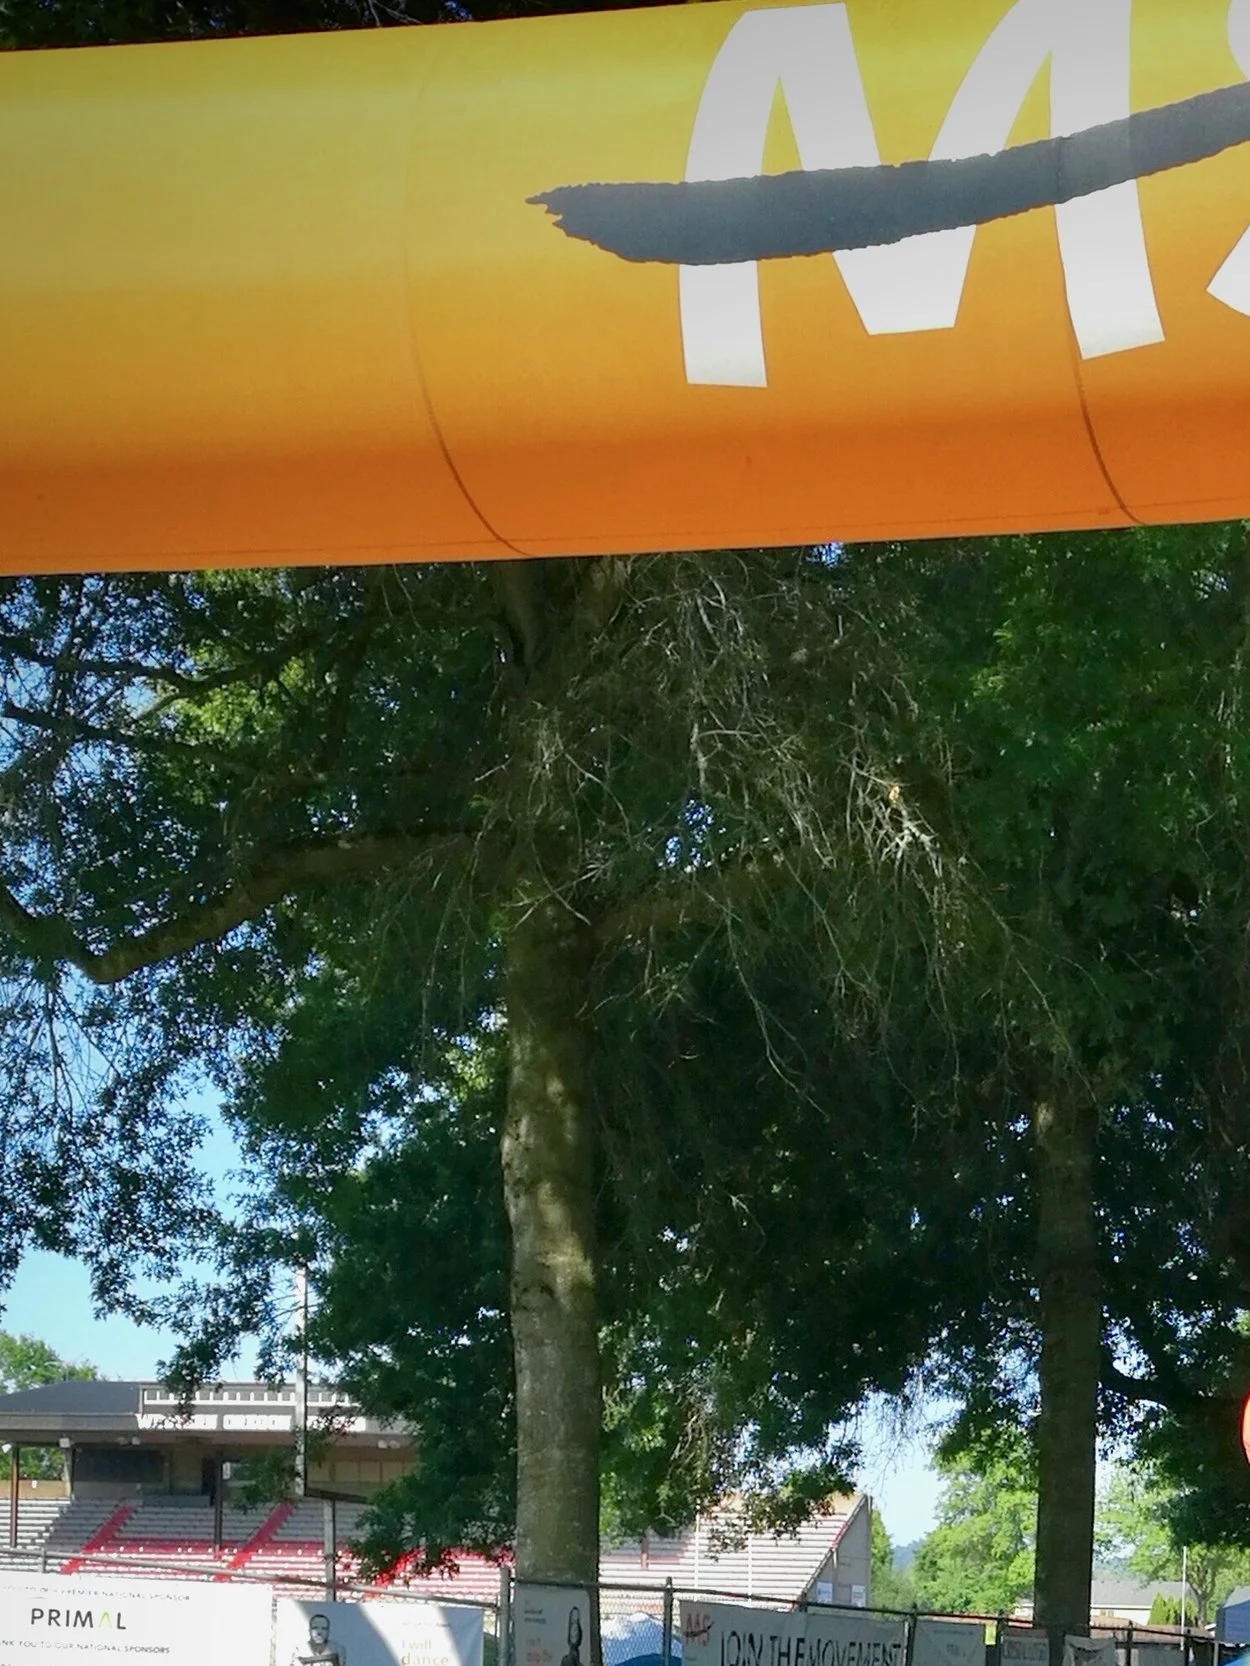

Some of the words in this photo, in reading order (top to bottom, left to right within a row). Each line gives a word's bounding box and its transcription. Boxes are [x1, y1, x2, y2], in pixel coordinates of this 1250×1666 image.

[31, 1608, 126, 1630] PRIMAL
[124, 1645, 170, 1654] SPONSORS
[401, 1651, 449, 1666] dance
